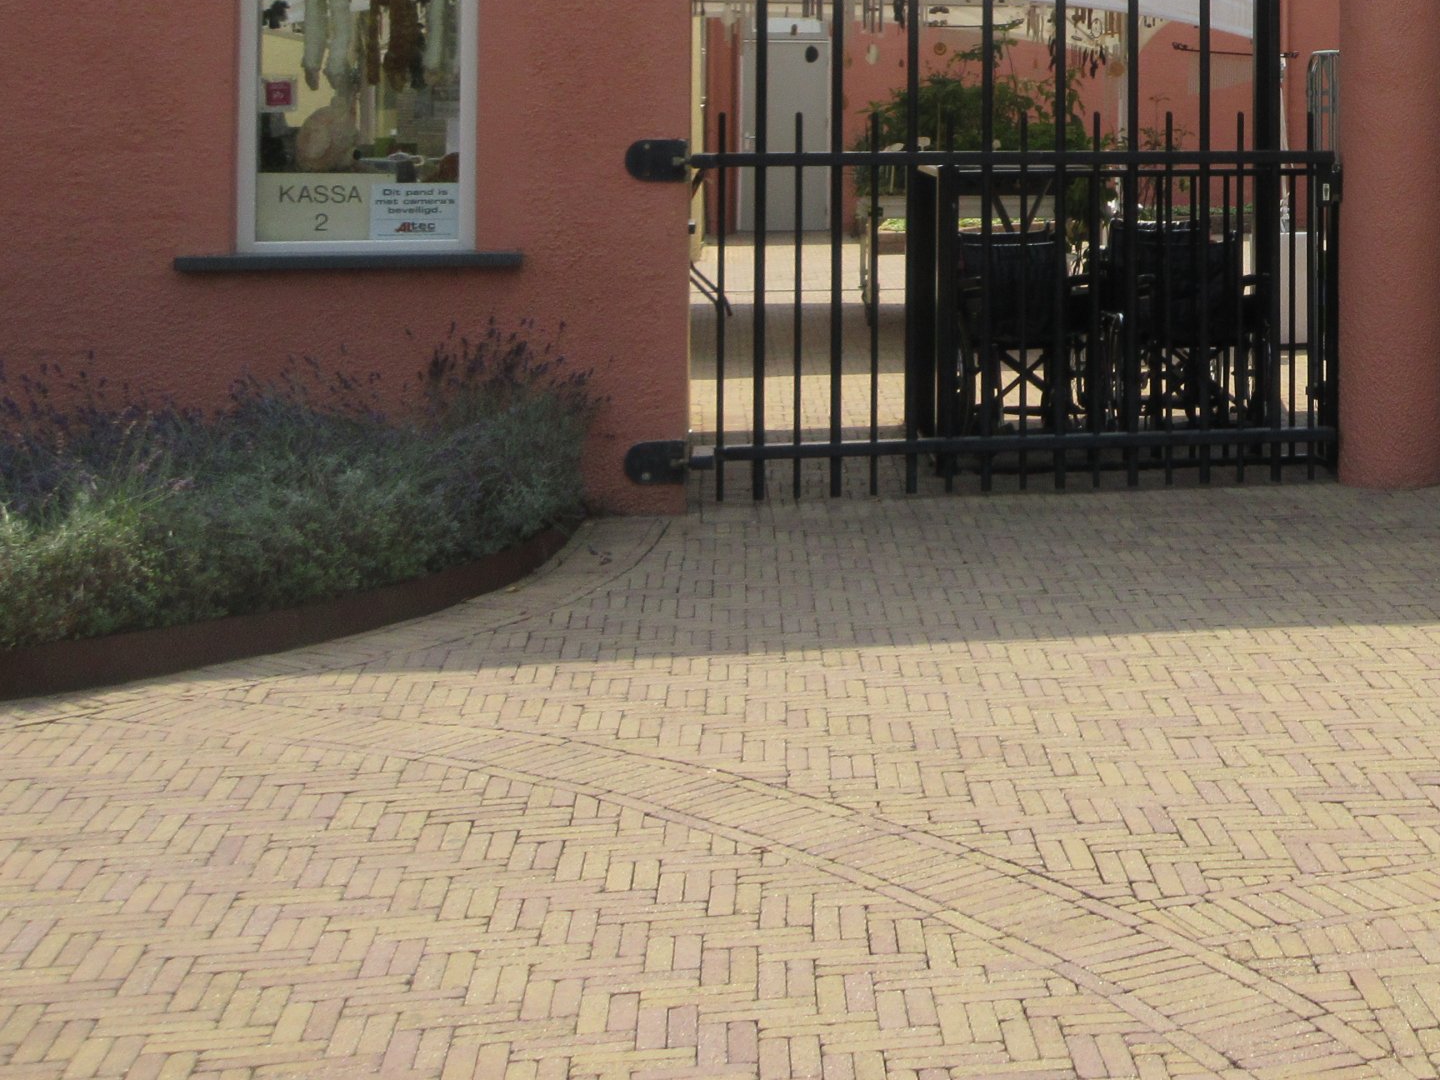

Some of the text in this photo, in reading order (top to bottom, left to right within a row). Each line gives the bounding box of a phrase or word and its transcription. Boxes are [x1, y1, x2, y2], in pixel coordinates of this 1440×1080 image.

[278, 185, 363, 203] KASSA
[382, 188, 448, 197] Dit pand is
[314, 213, 329, 231] 2
